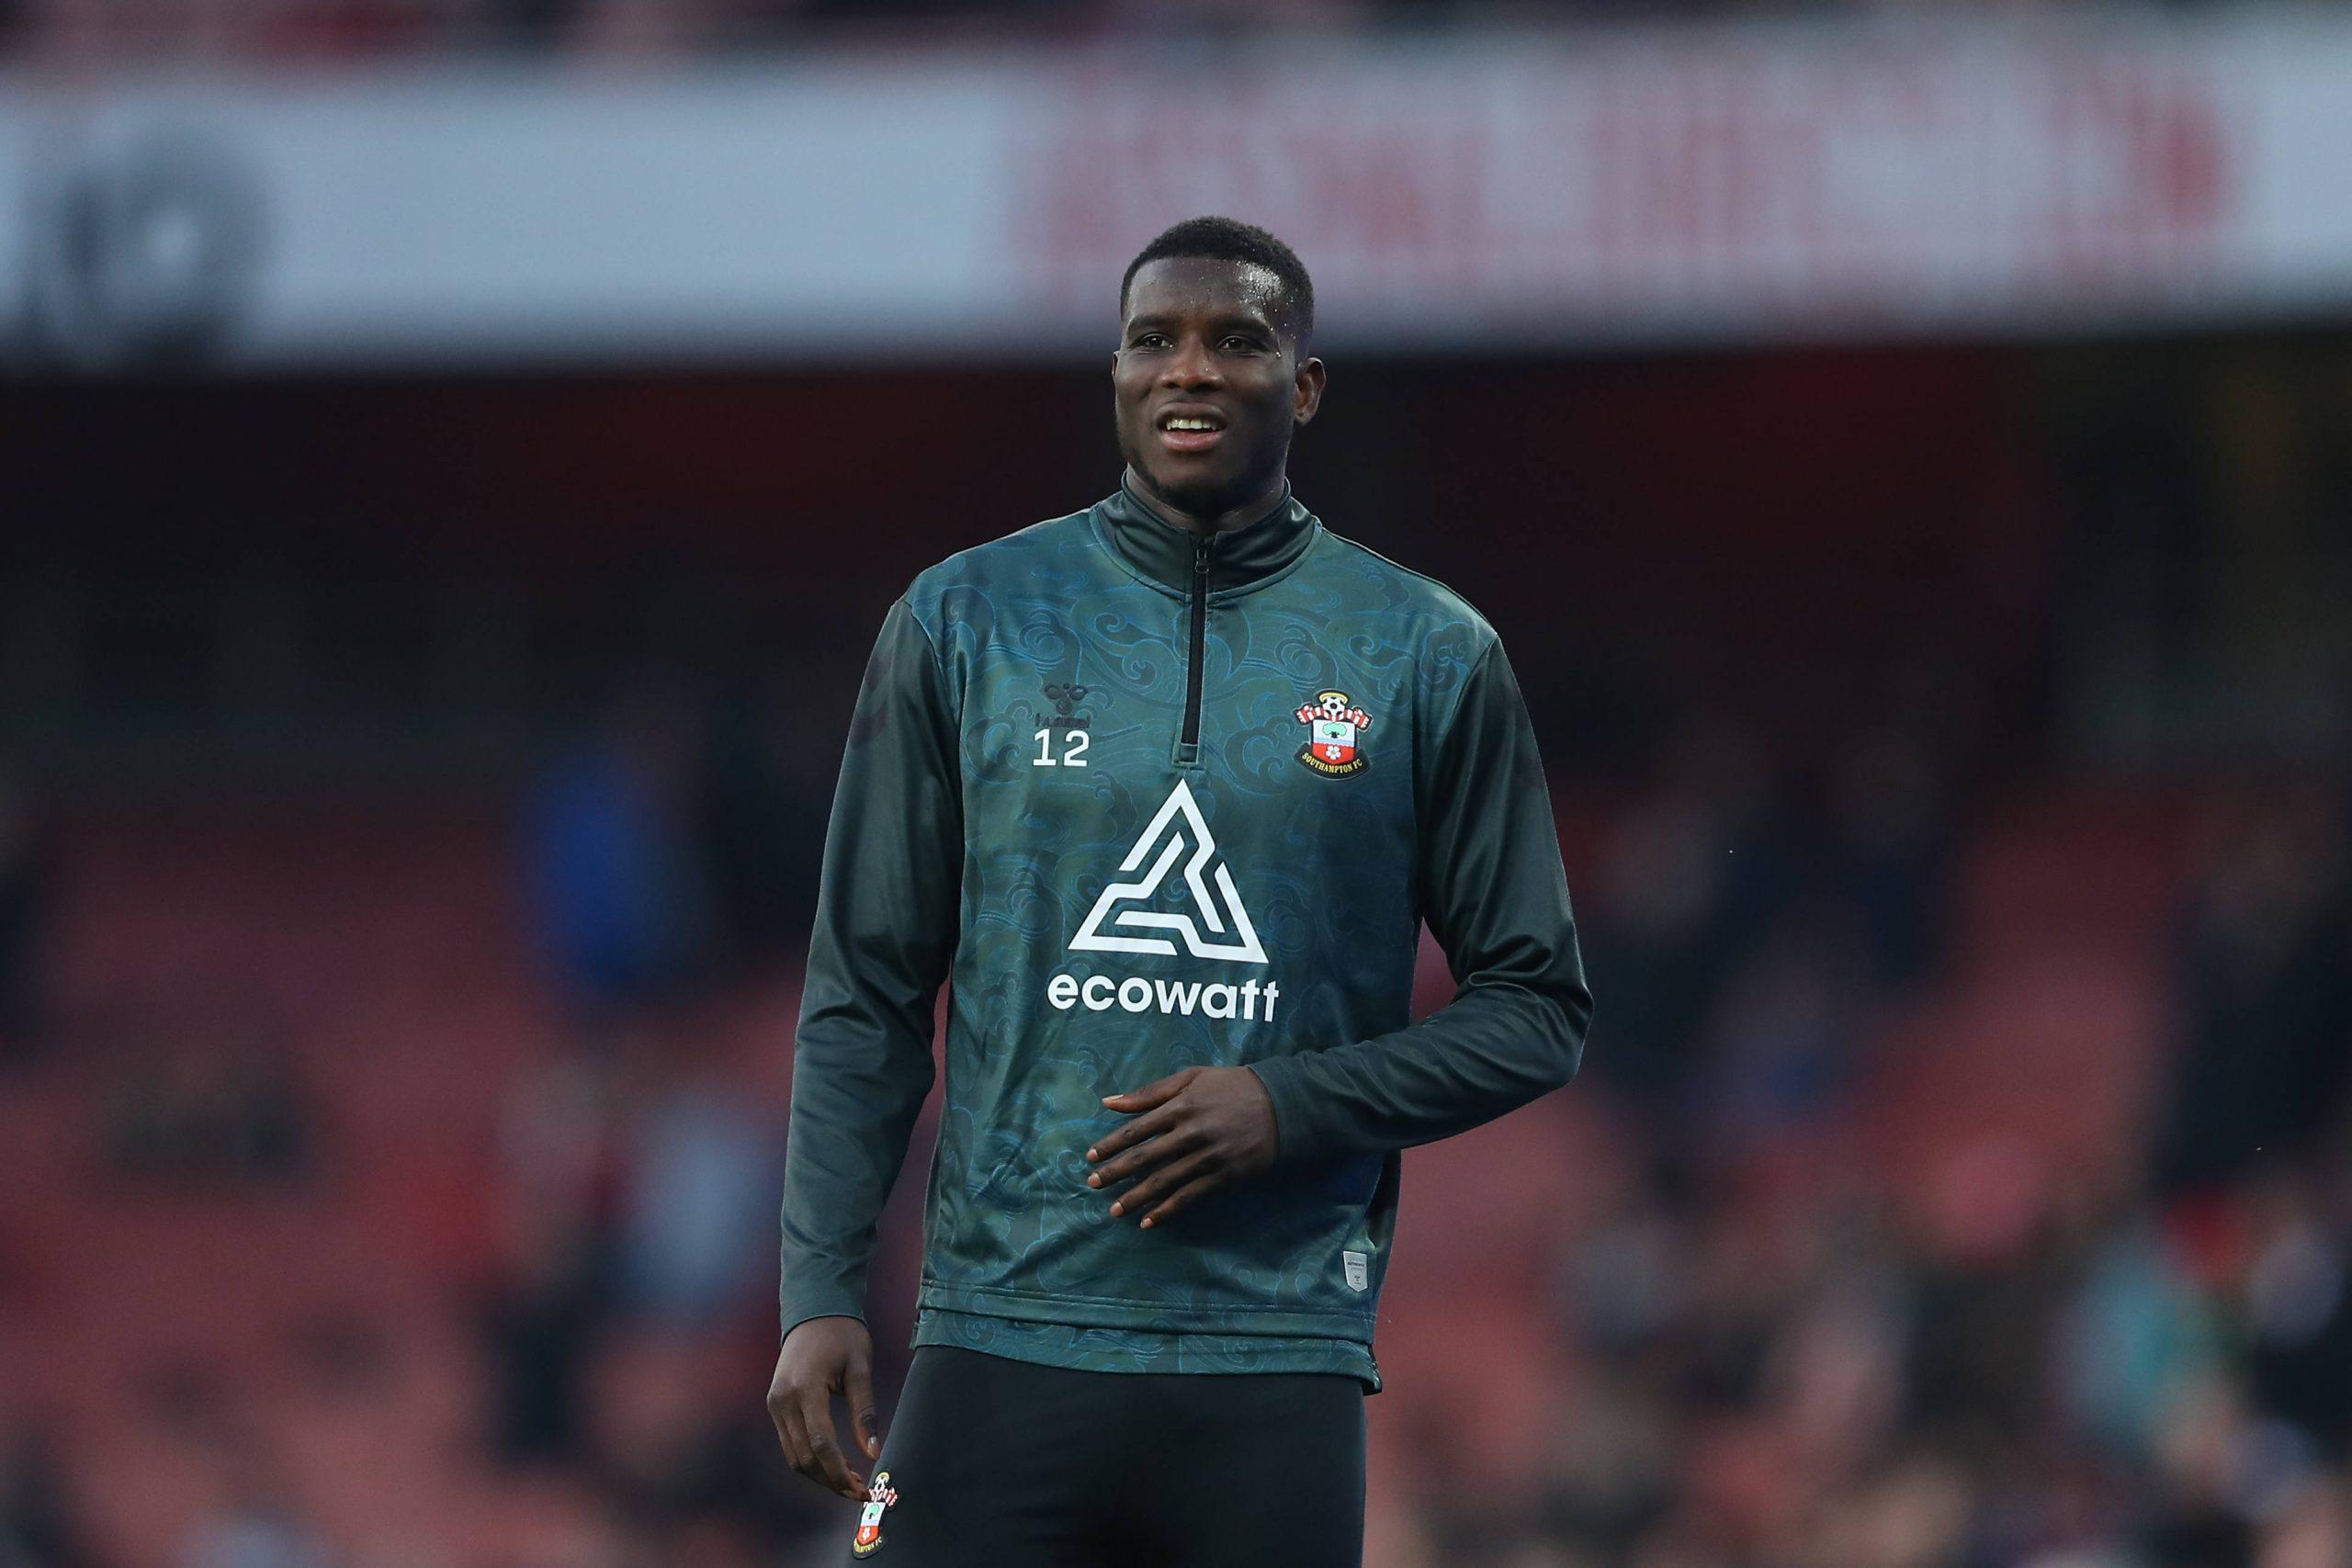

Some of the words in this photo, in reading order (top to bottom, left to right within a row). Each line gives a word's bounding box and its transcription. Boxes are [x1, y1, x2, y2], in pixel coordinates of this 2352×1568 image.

[1033, 728, 1090, 767] 12
[1301, 752, 1353, 773] SOUTHAMPTON
[1352, 759, 1363, 770] FC
[1047, 974, 1279, 1022] ecowatt
